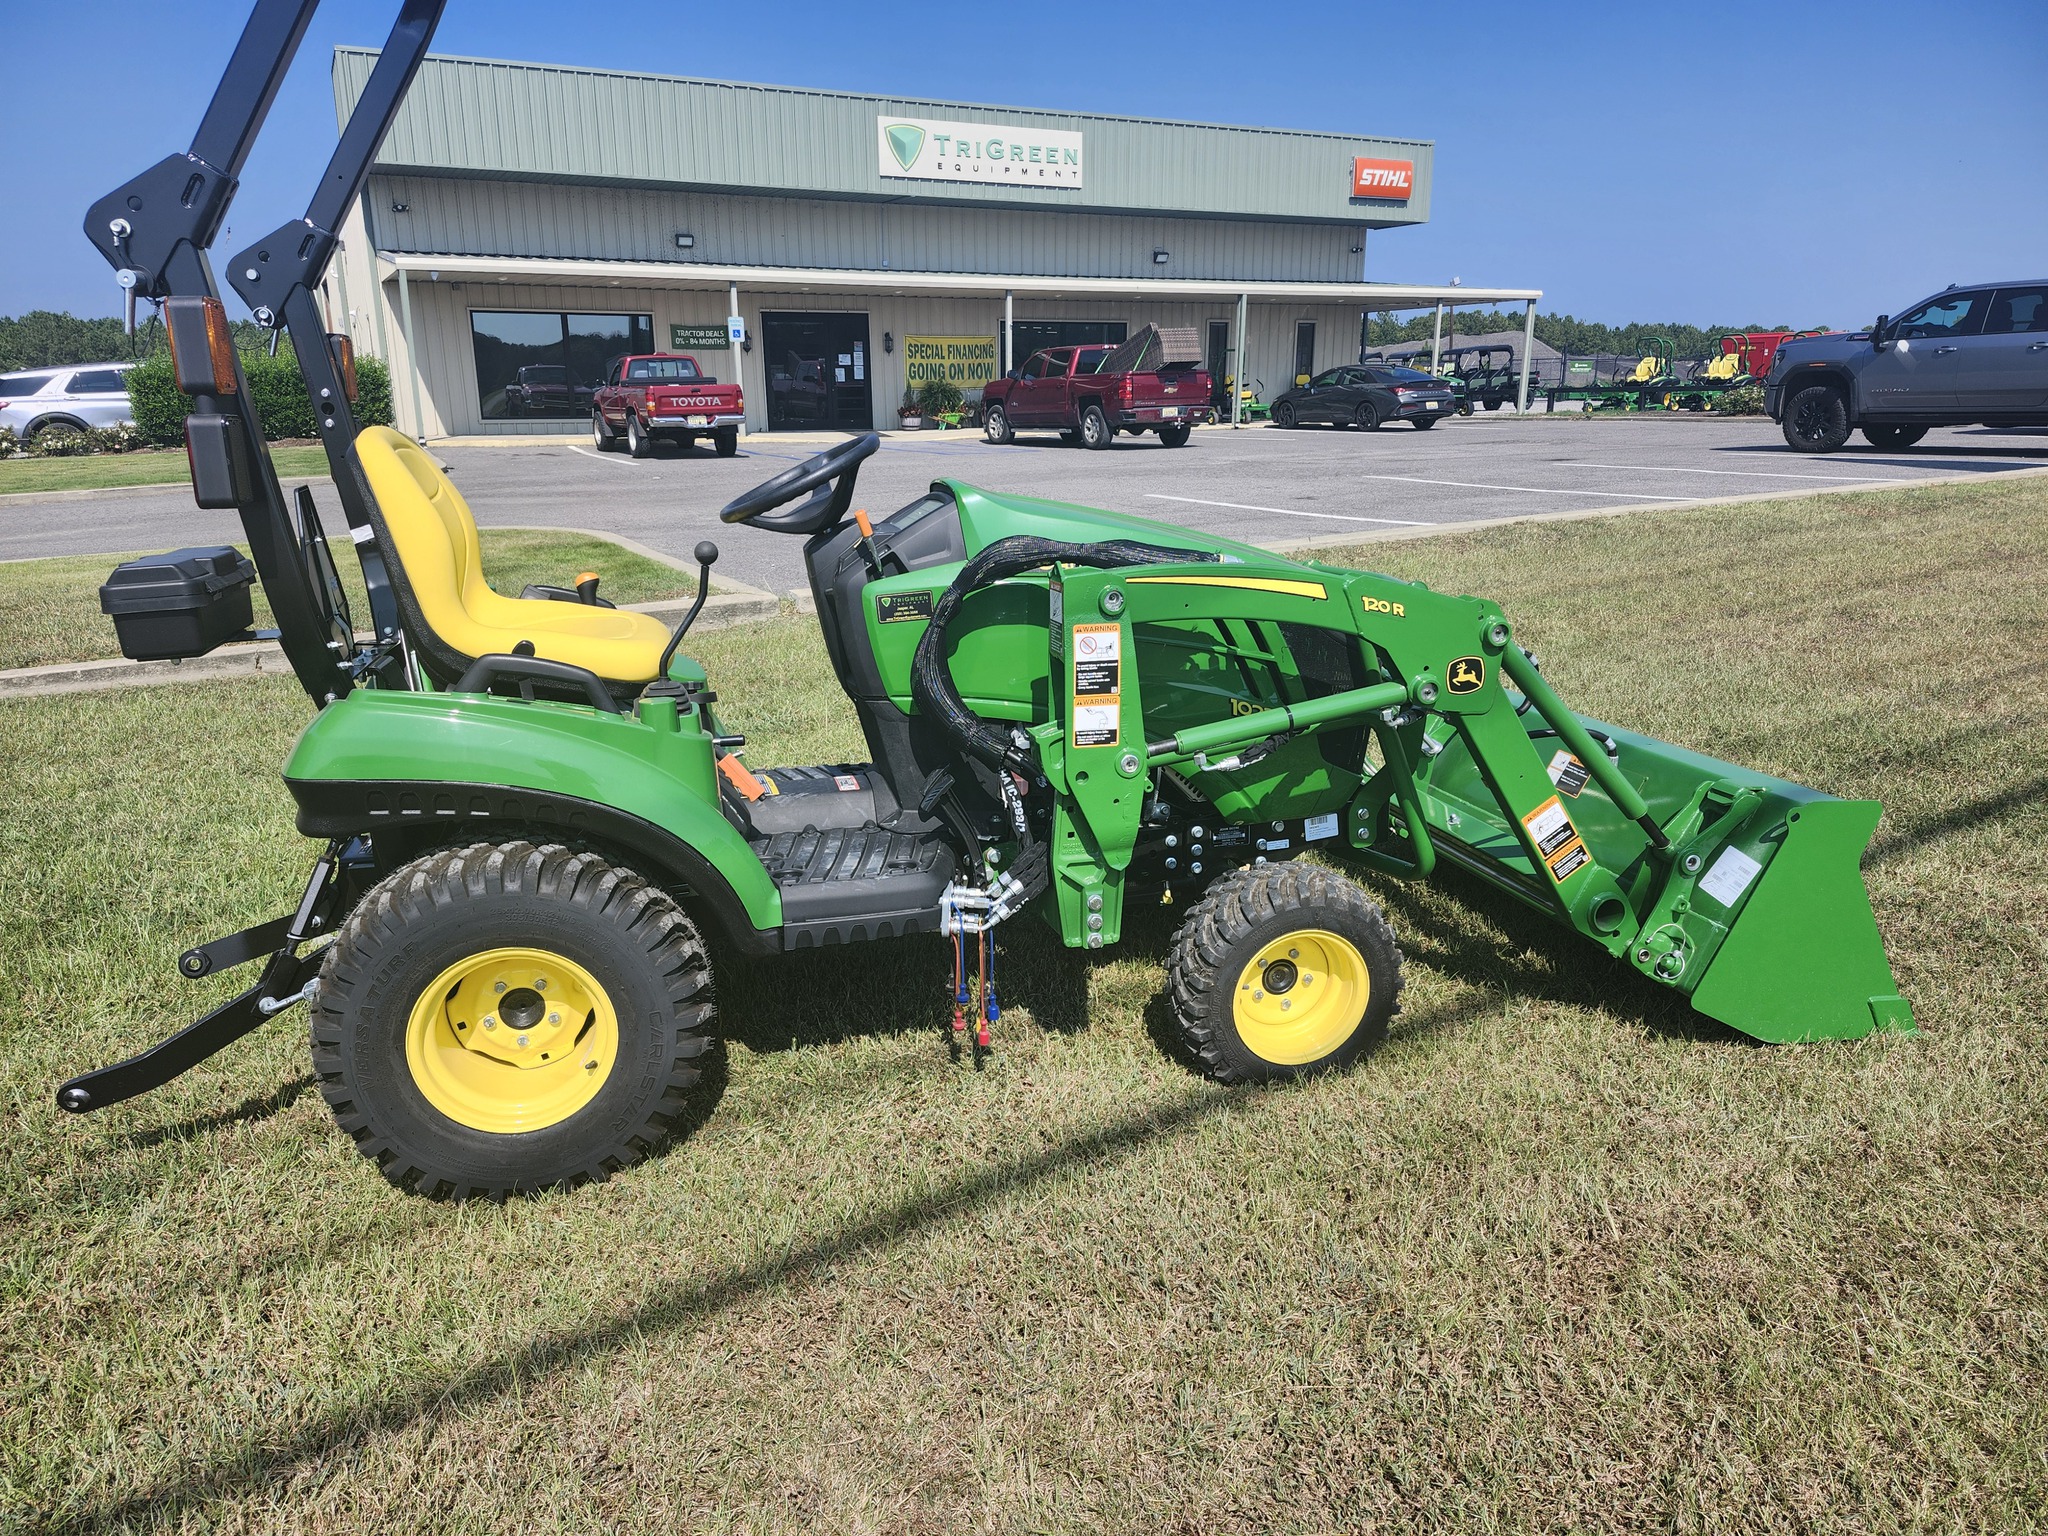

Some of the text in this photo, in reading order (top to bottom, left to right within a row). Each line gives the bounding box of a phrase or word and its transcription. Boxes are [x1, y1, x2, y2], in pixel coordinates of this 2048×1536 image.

[933, 133, 1078, 166] TRIGREEN
[937, 162, 1078, 179] EQUIPMENT
[1359, 168, 1409, 188] STIHL
[676, 329, 705, 337] TRACTOR
[907, 343, 995, 360] SPECIAL FINANCING
[908, 362, 994, 381] GOING ON NOW
[670, 396, 722, 407] TOYOTA
[1082, 624, 1118, 633] WARNING
[1083, 697, 1118, 706] WARNING
[1230, 698, 1272, 716] 10
[353, 941, 420, 1092] VERSA TURF
[609, 1010, 664, 1133] CARLSTAR
